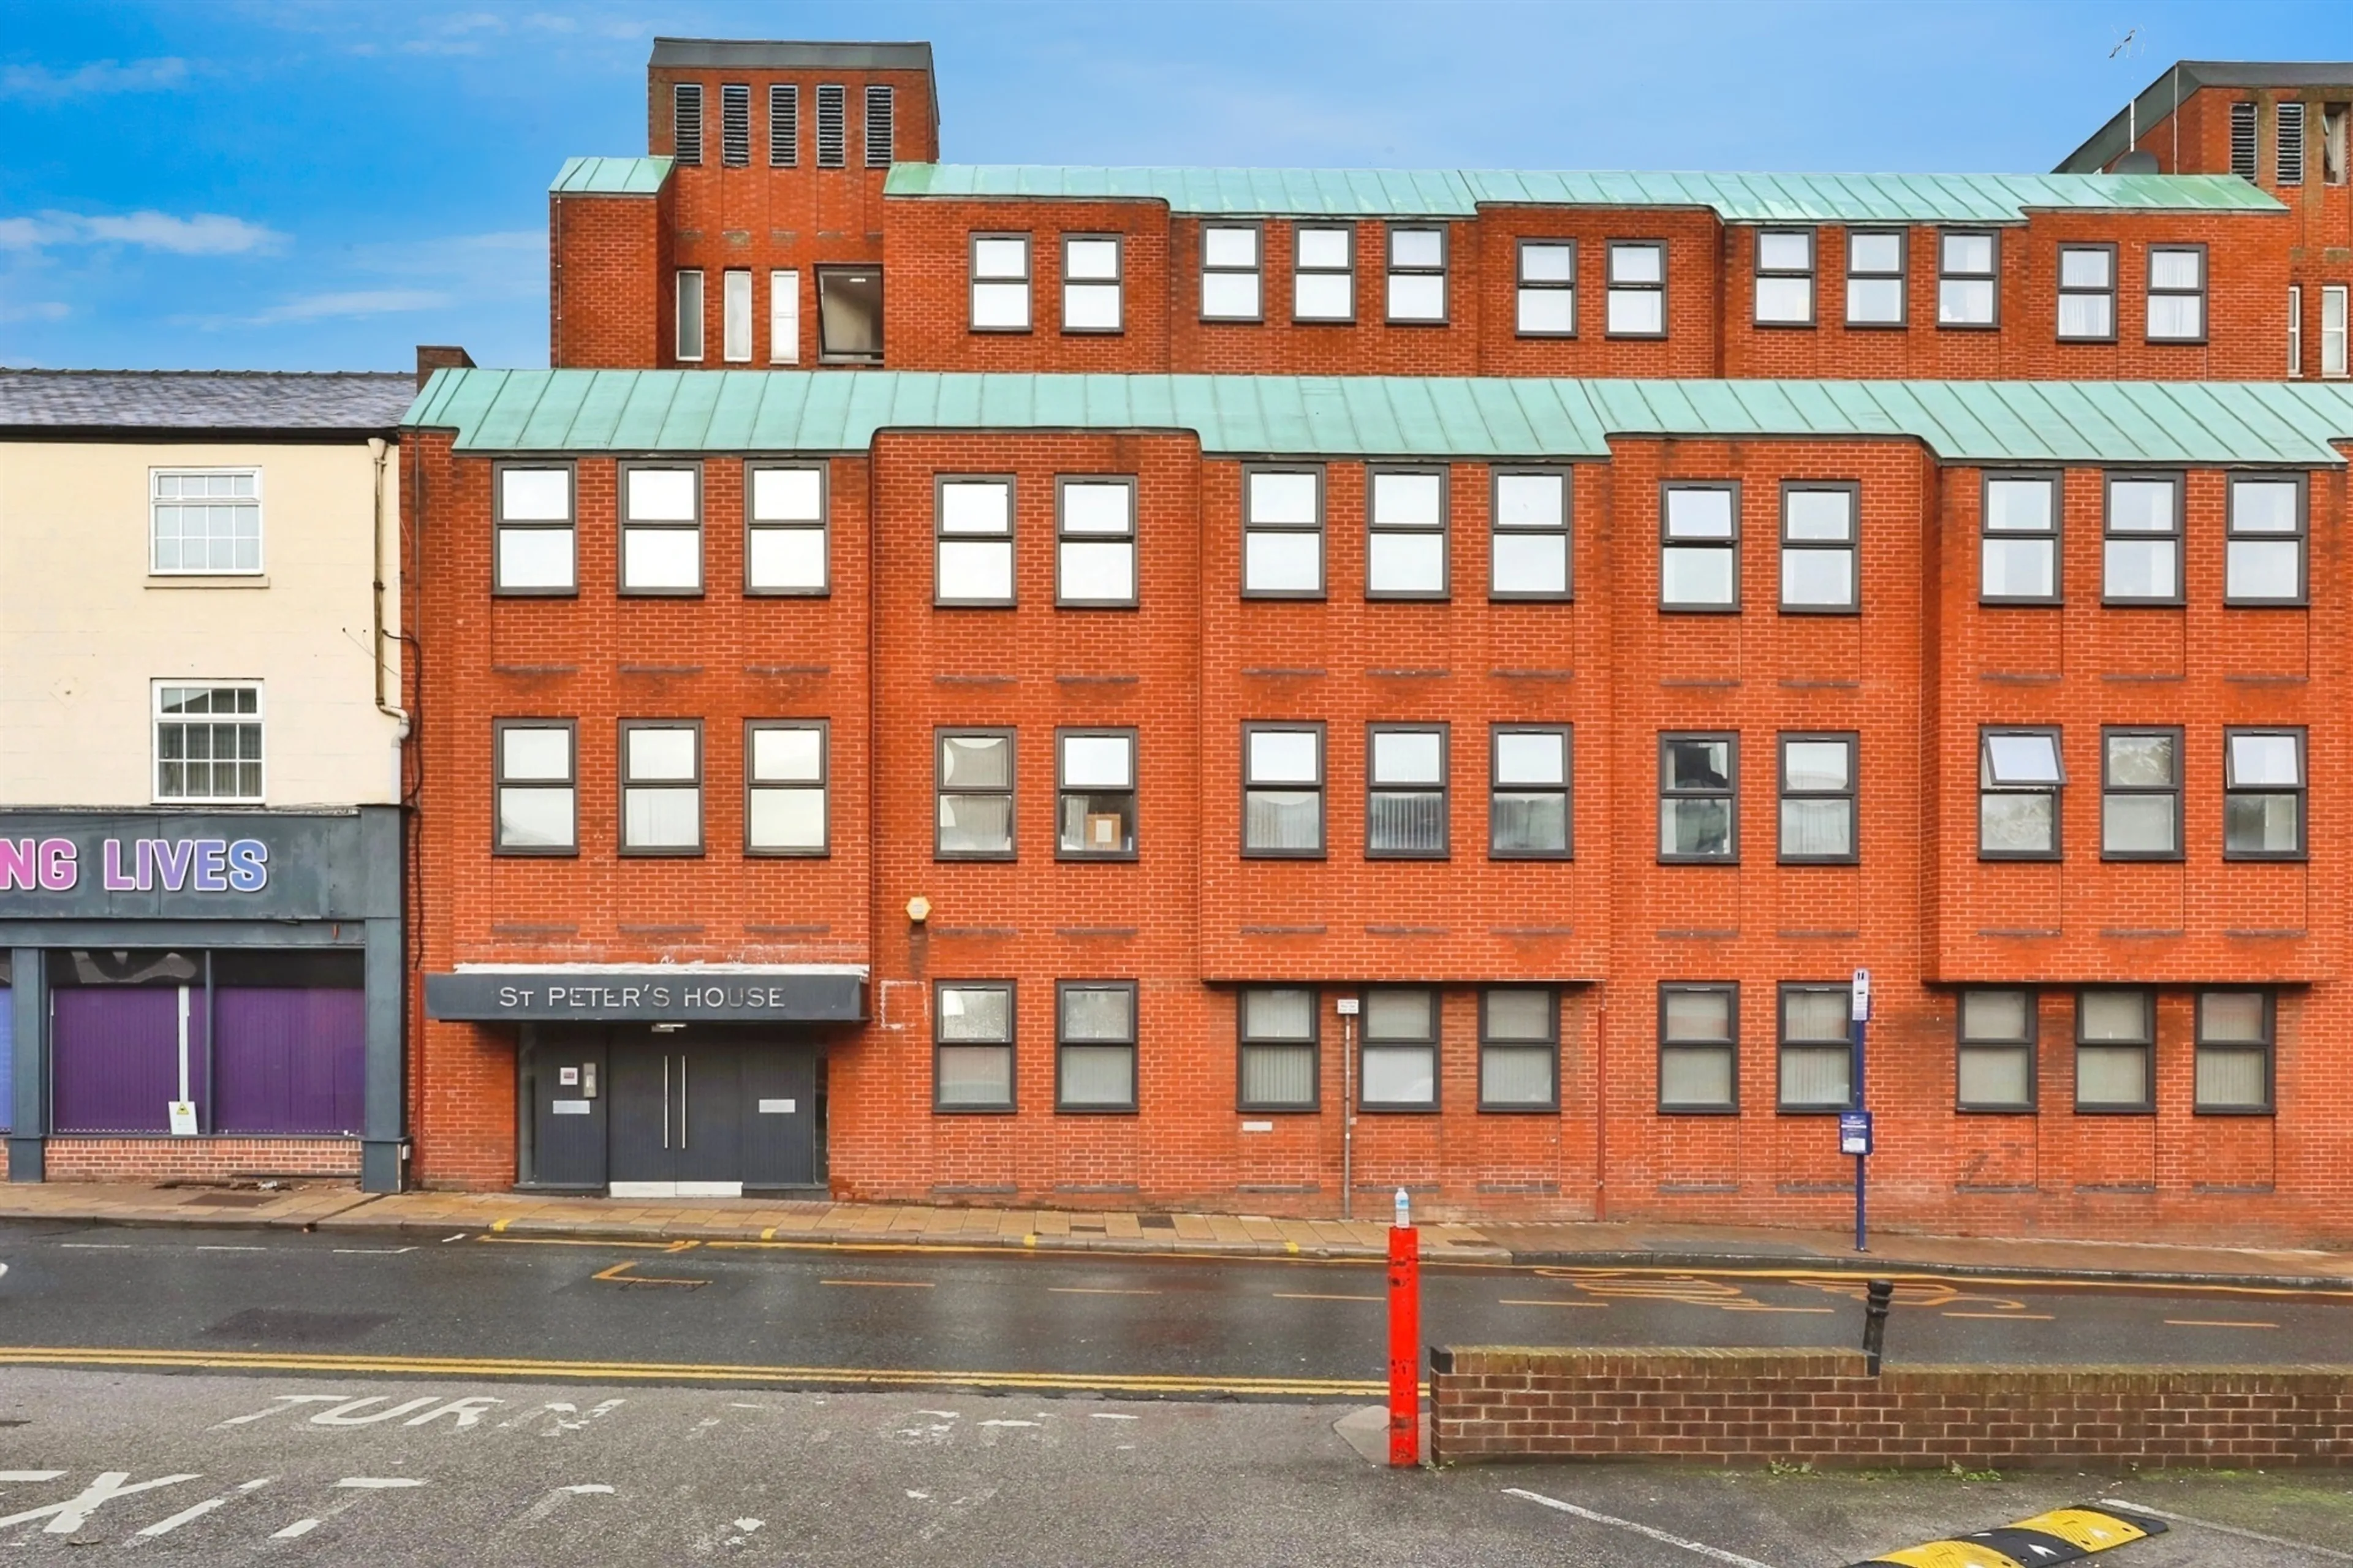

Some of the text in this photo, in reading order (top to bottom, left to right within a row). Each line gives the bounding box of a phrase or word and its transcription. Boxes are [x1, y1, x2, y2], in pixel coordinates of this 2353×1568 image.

[104, 838, 268, 892] LIVES
[549, 984, 670, 1007] PETER'S
[684, 987, 785, 1007] HOUSE
[207, 1394, 626, 1437] TURN
